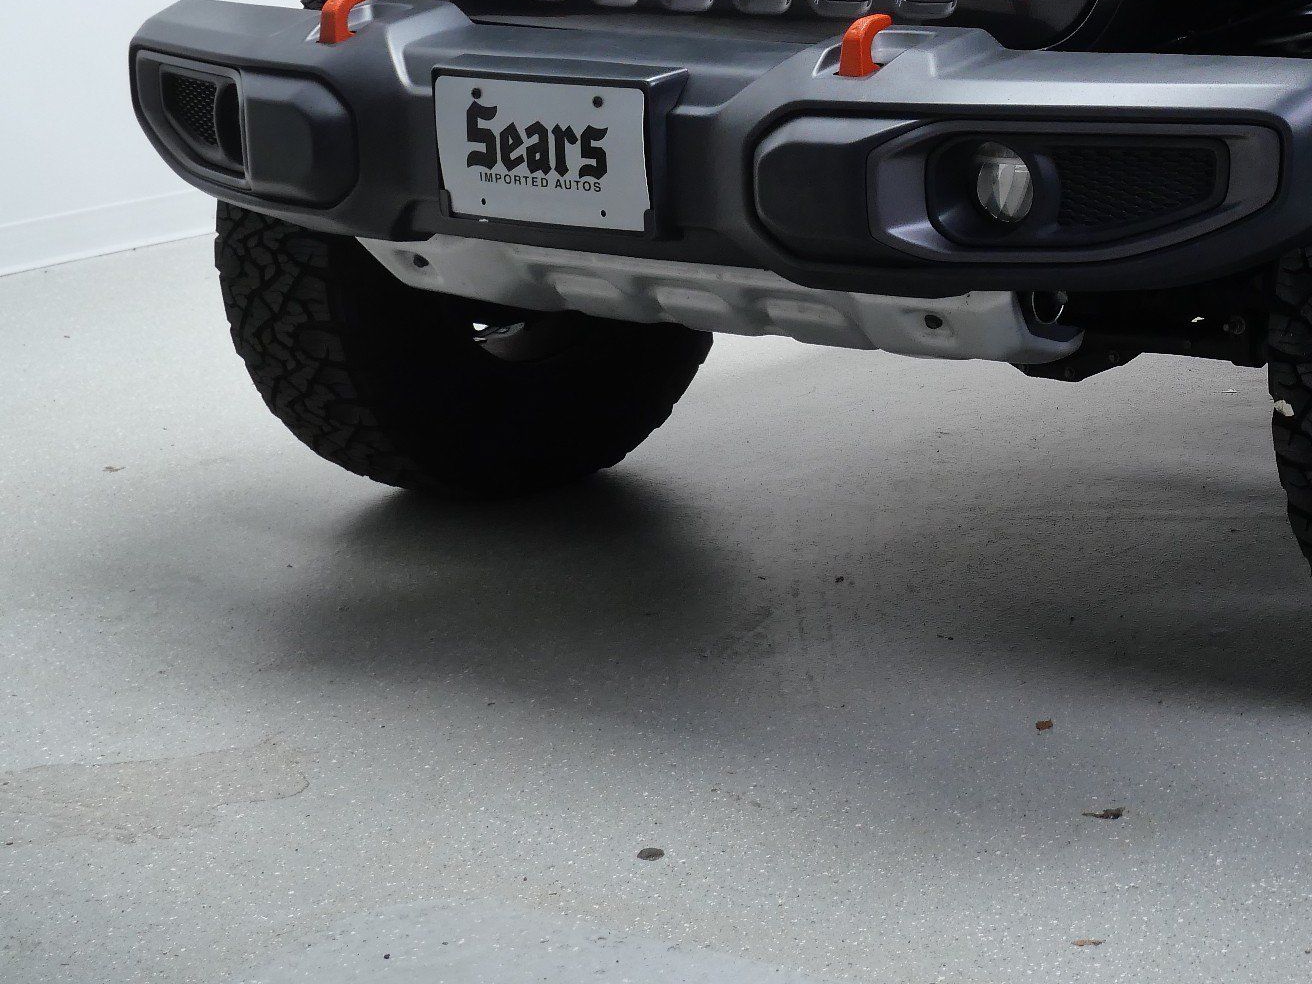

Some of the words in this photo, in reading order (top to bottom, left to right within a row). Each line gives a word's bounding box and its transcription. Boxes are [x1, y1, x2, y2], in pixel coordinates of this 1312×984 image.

[466, 101, 608, 180] Sears
[479, 172, 549, 188] IMPORTED
[555, 180, 602, 193] AUTOS
